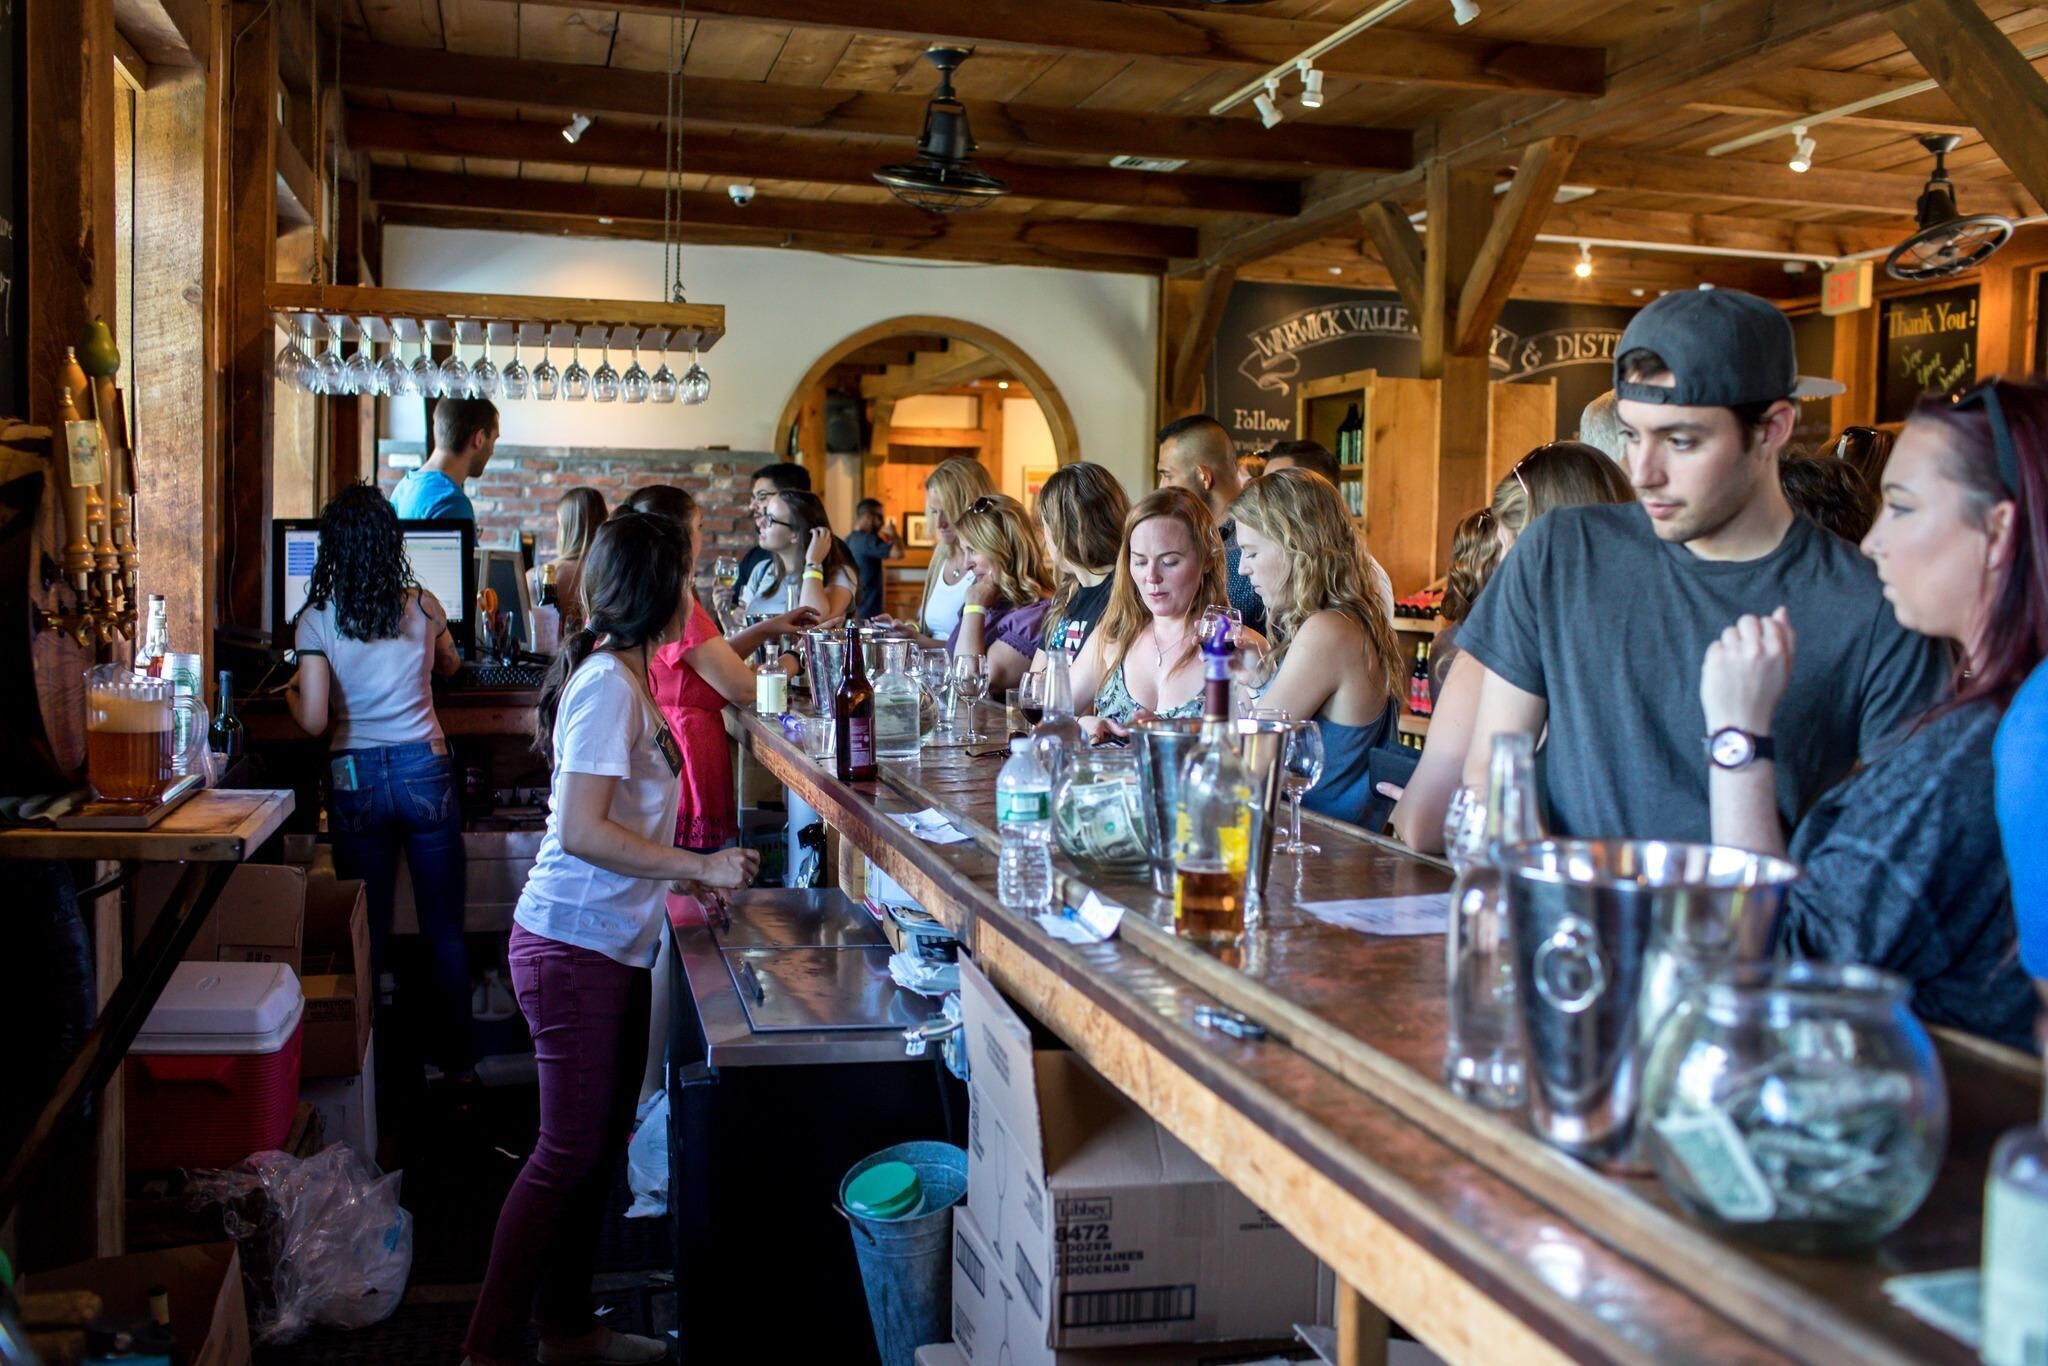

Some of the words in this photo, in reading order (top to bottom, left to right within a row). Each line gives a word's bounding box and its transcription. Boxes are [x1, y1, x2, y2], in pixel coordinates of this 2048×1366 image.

[1885, 307, 1935, 338] Thank
[1936, 299, 1977, 332] You!
[1253, 310, 1345, 357] WARWICK
[1344, 306, 1419, 334] VALLE
[1233, 408, 1291, 432] Follow
[1055, 1224, 1110, 1242] 8472
[1066, 1242, 1112, 1253] DOZEN
[1066, 1251, 1144, 1264] DOUZAINES
